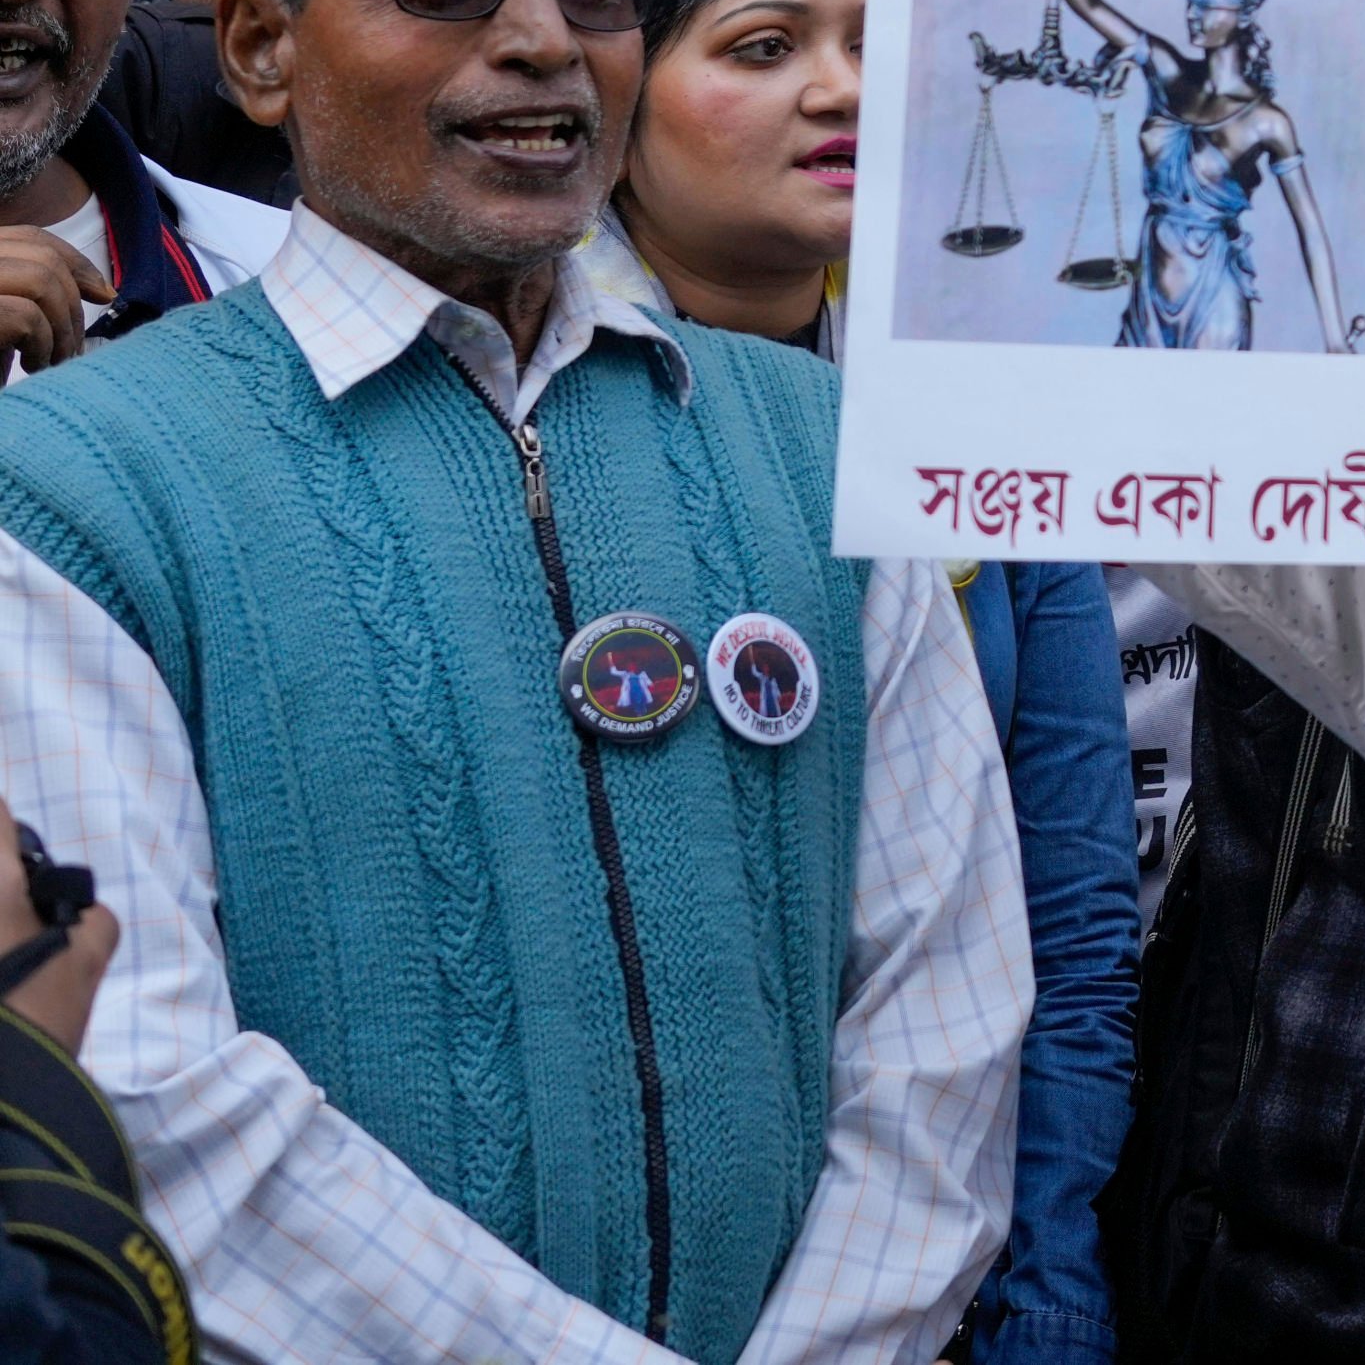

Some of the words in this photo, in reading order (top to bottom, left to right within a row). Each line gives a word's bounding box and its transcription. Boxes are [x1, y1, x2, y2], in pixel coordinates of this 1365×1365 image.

[914, 467, 1073, 550] সঞ্জয়
[1095, 465, 1224, 542] একা
[579, 702, 601, 723] WE
[598, 719, 654, 733] DEMAND
[655, 683, 694, 728] JUSTICE
[724, 683, 738, 704] NO
[735, 702, 750, 723] TO
[785, 682, 813, 730] CULTURE
